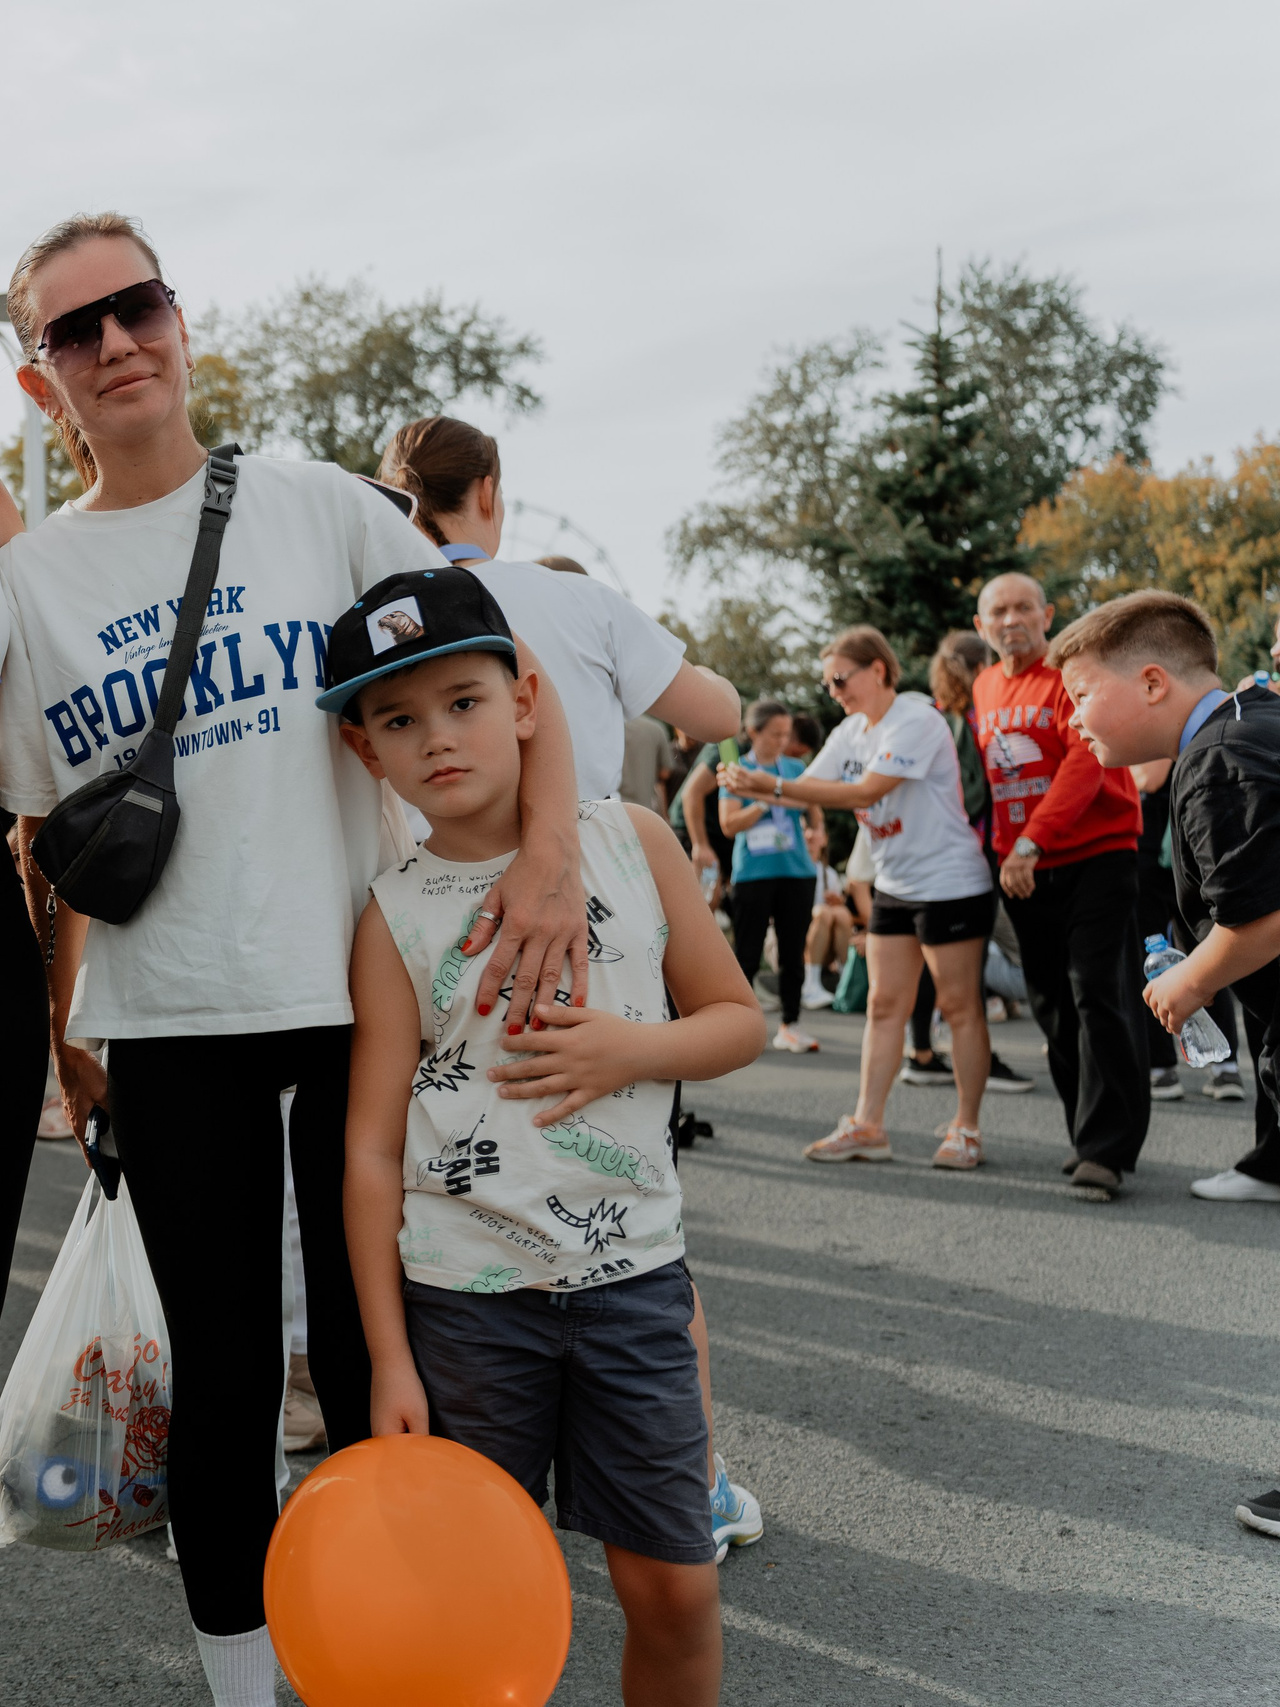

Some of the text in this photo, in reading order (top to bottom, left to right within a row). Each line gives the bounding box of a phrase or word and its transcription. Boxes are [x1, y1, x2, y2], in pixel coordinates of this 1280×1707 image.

[97, 603, 161, 656] NEW
[124, 643, 156, 665] Vintage
[257, 706, 281, 735] 91
[421, 884, 452, 896] ENJOY
[472, 1139, 500, 1178] OH
[469, 1209, 506, 1233] ENJOY
[506, 1231, 557, 1264] SURFING
